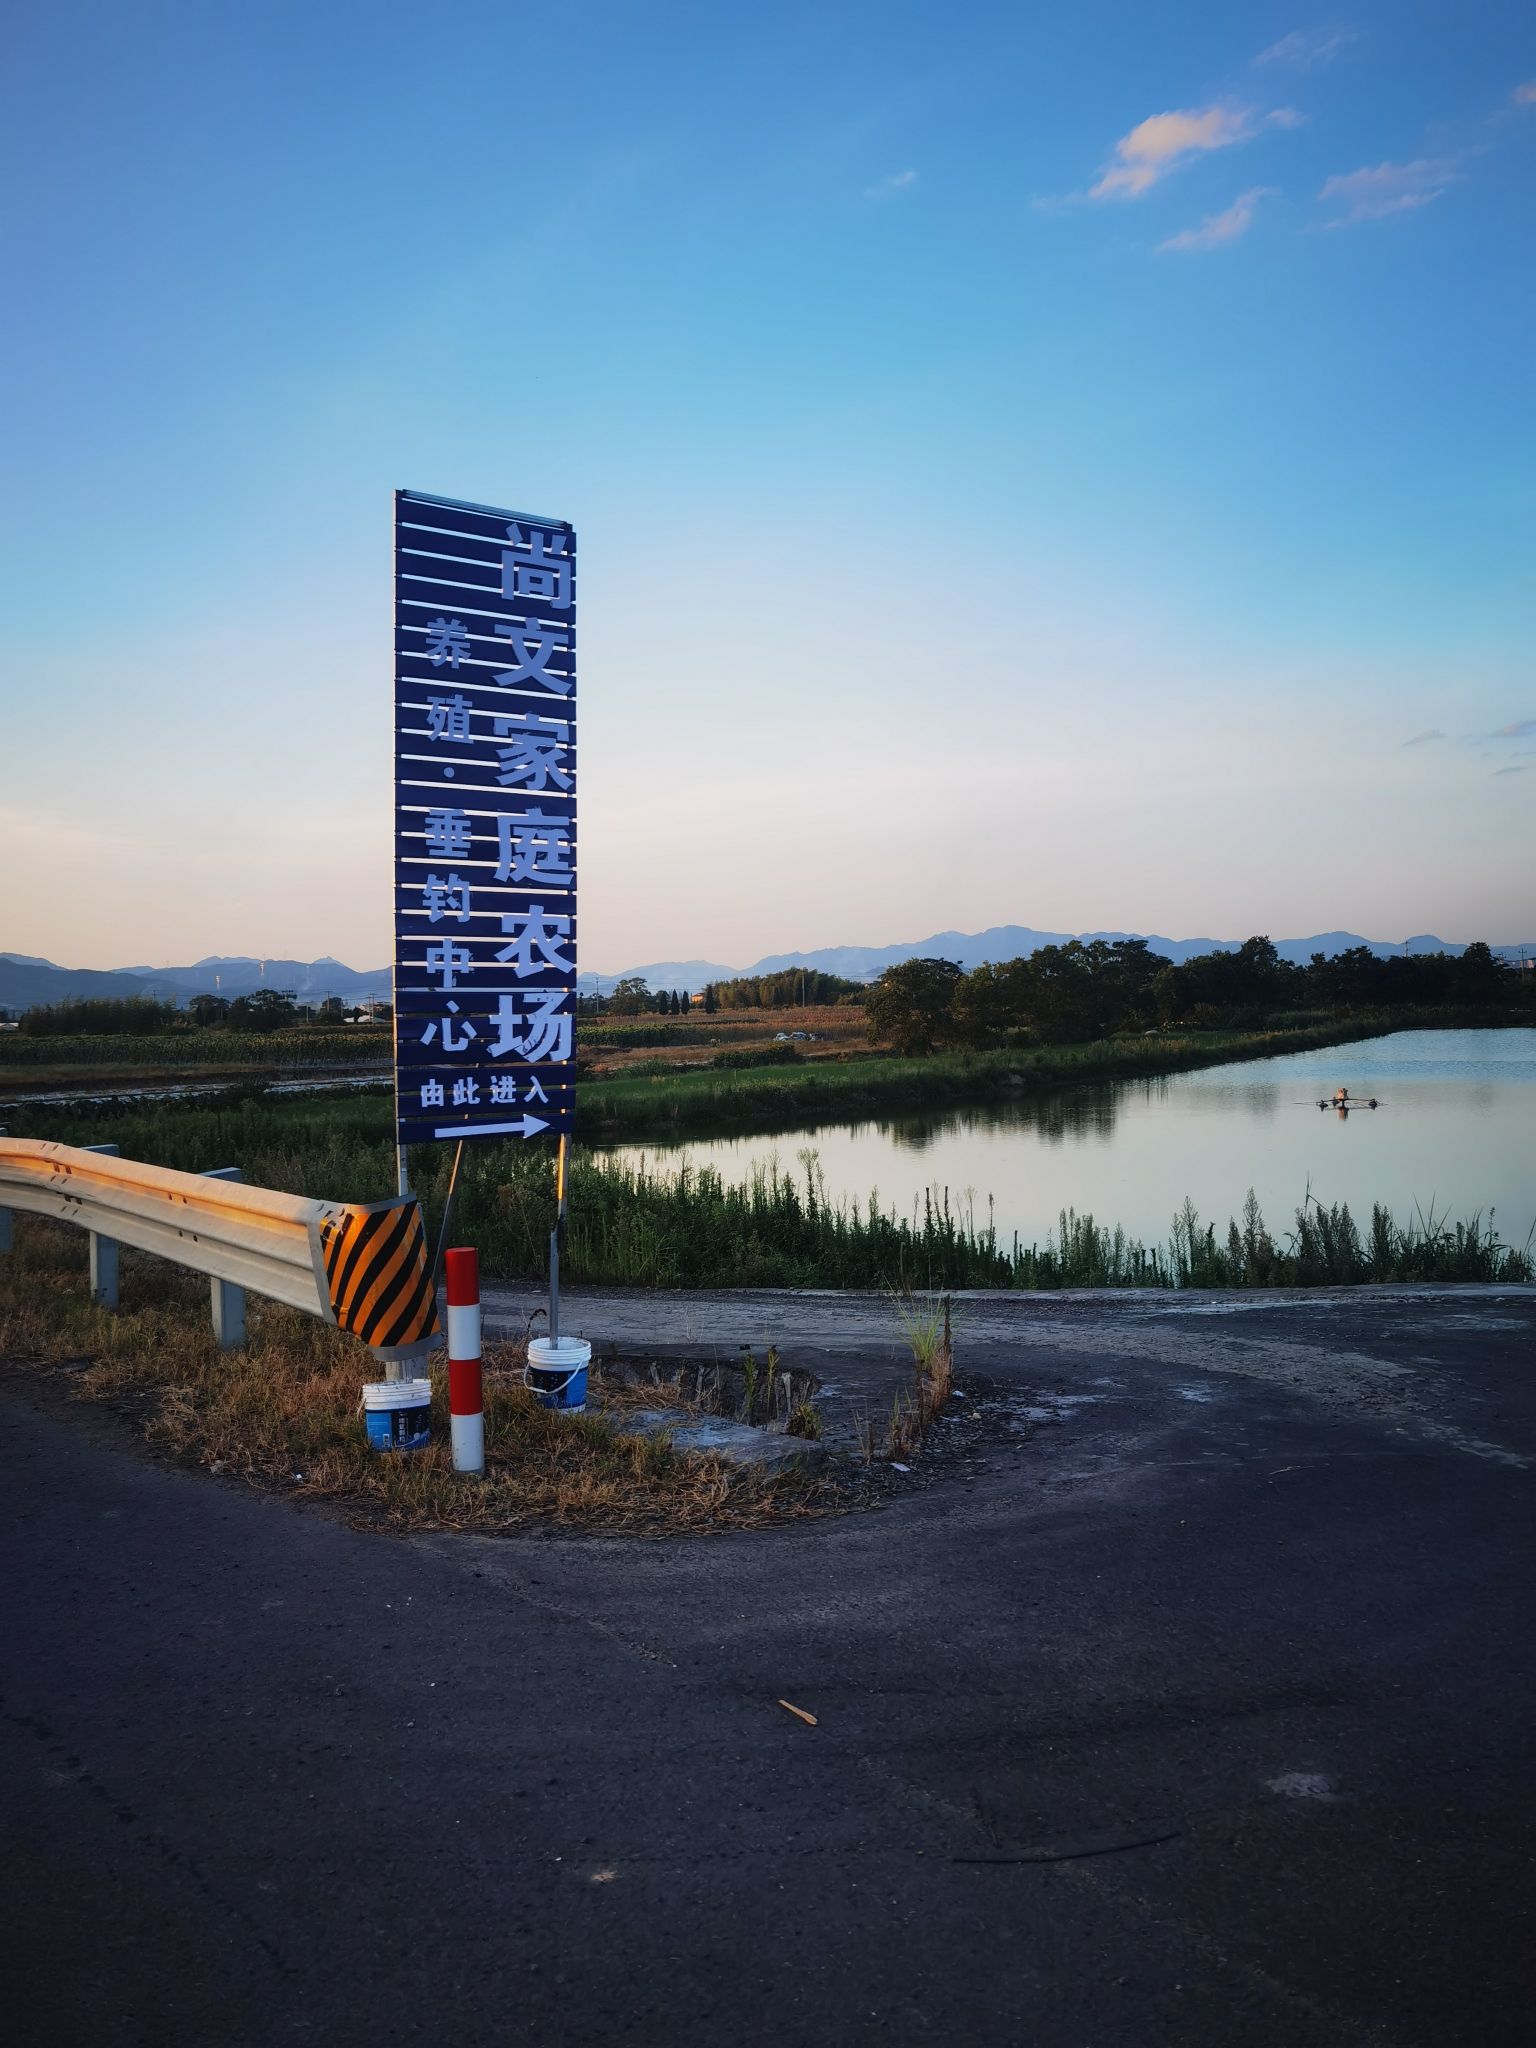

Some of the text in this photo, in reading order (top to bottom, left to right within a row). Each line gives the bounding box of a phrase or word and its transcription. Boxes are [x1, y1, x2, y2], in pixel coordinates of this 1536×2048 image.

[488, 523, 574, 1063] 尚文家庭农场
[421, 1075, 548, 1107] 由此进入
